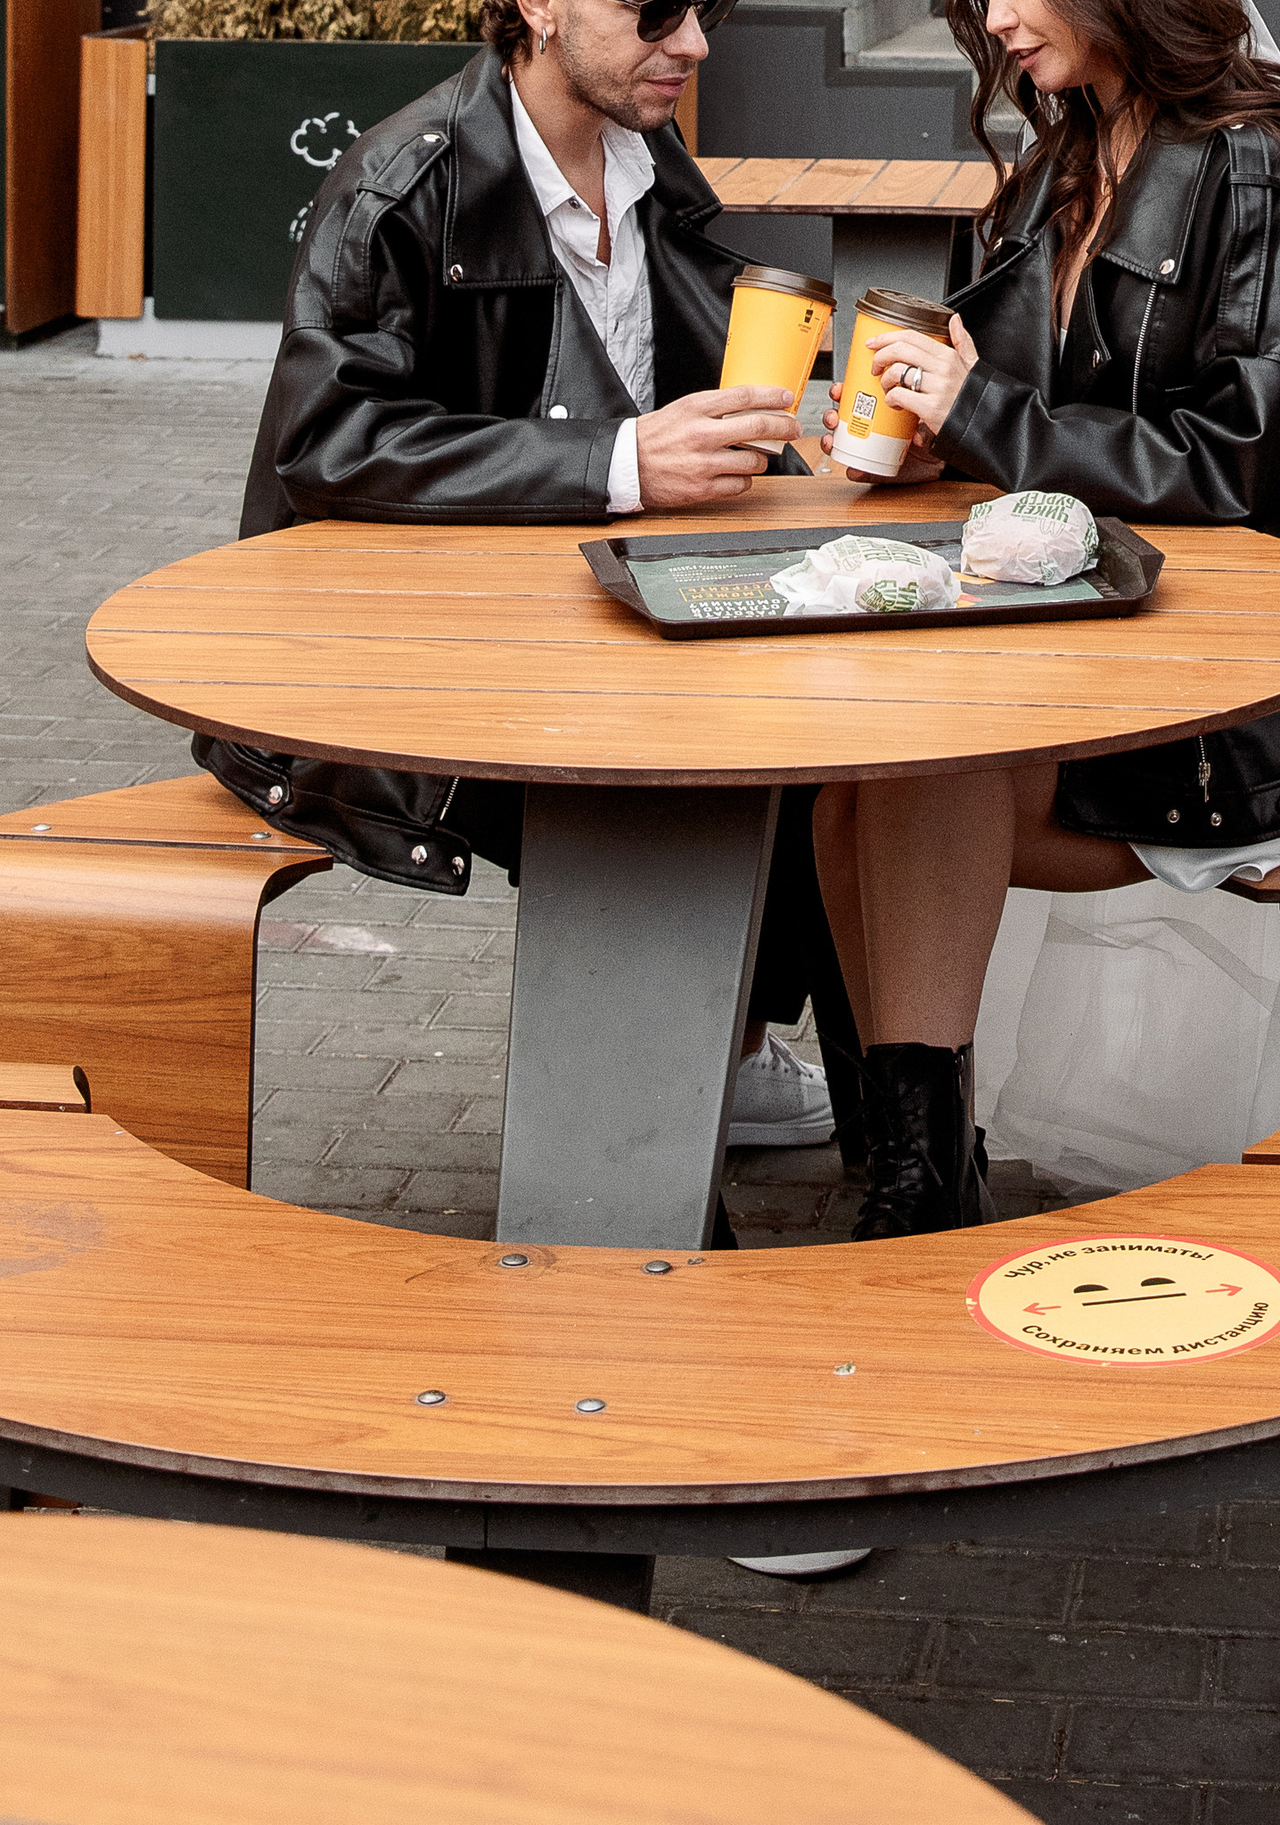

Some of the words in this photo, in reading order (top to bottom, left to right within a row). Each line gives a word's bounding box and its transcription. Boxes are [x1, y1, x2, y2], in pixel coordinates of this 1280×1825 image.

[1019, 492, 1076, 510] БУРГЕР
[1012, 502, 1069, 524] ЧИКЕН
[688, 582, 772, 593] УСТРОИТЬ
[690, 591, 755, 600] МОЖЕМ
[690, 604, 780, 614] ОТЛИЧНОЙ
[693, 609, 777, 619] РАБОТАТЬ
[1004, 1257, 1051, 1280] Чур,
[1051, 1248, 1077, 1263] не
[1081, 1243, 1215, 1262] занимать!
[1021, 1323, 1165, 1356] Сохраняем
[1171, 1301, 1270, 1355] дистанцию
